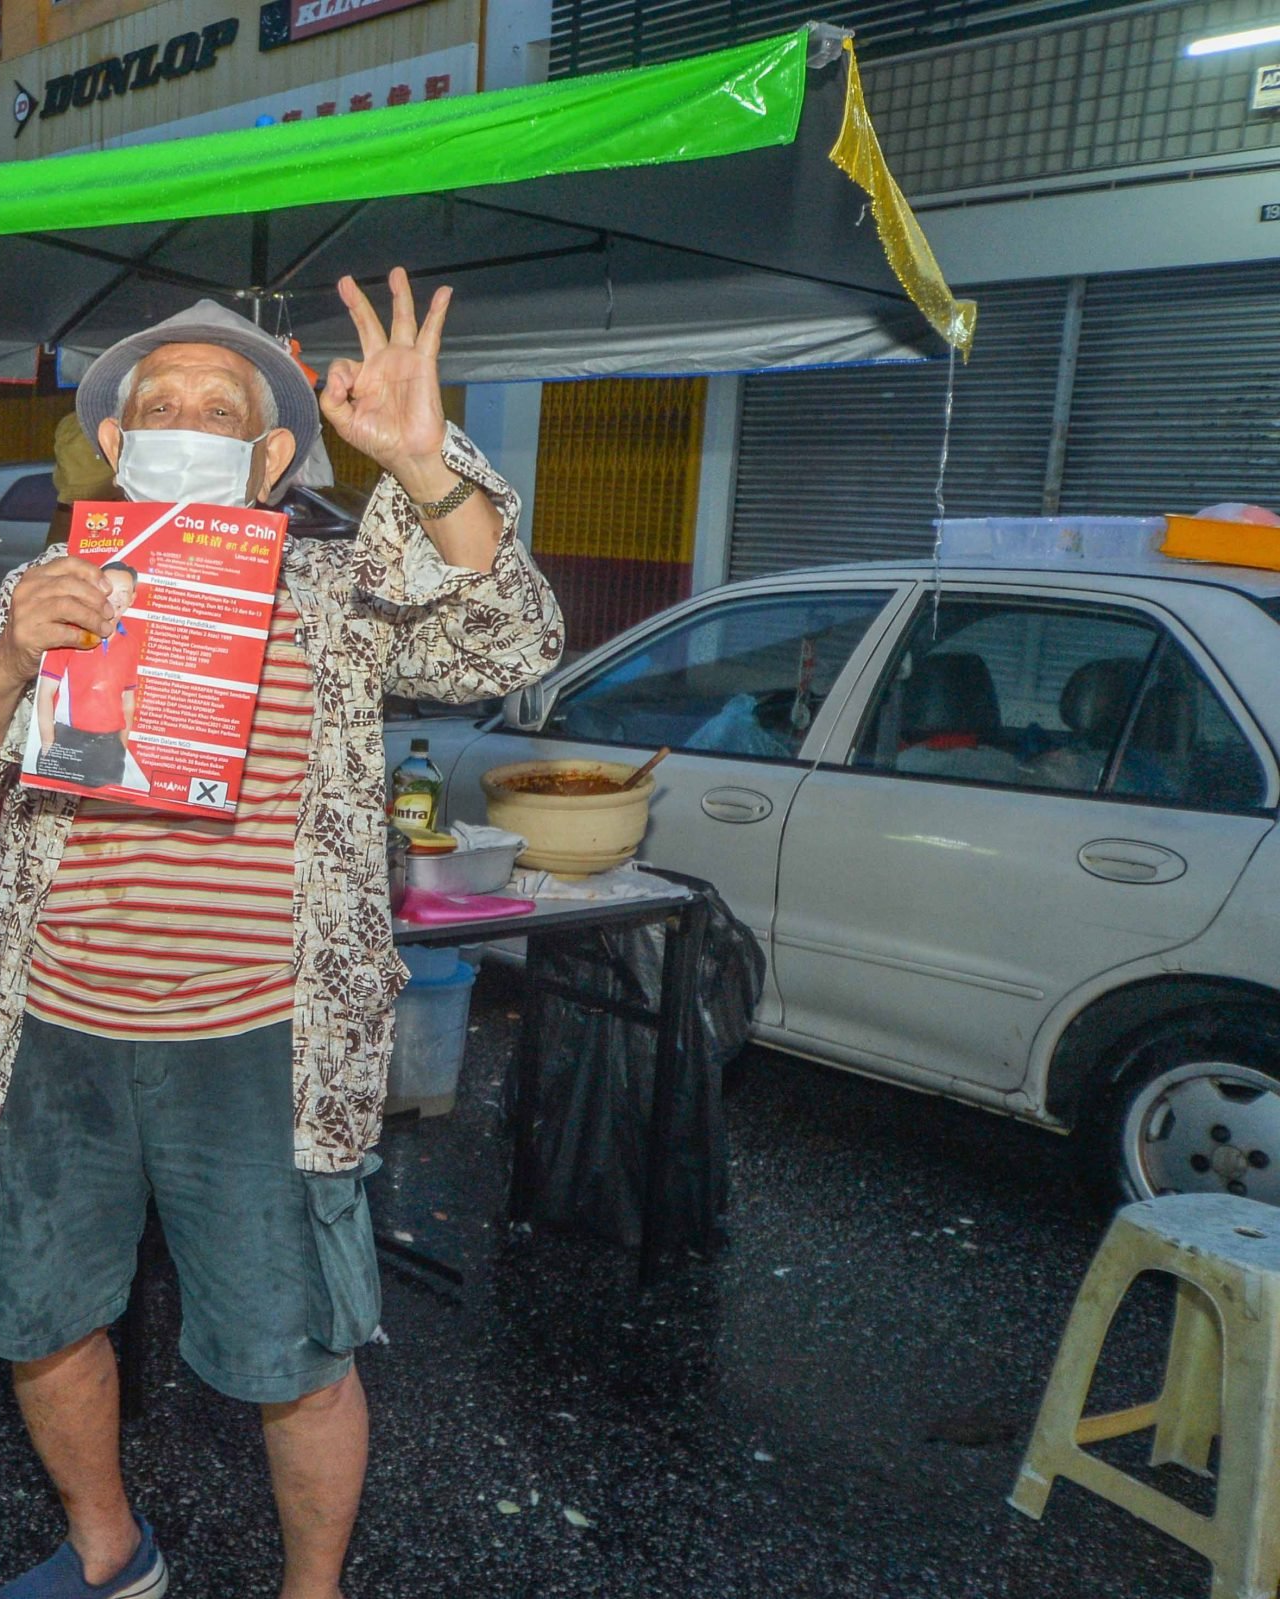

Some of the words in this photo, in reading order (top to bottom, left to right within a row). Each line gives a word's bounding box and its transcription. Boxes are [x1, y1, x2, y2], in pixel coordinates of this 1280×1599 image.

[39, 17, 239, 119] DUNLOP
[174, 516, 204, 530] Cha
[210, 518, 239, 534] Kee
[245, 524, 276, 540] Chin
[80, 538, 124, 548] Biodata
[154, 781, 188, 792] HARAPAN
